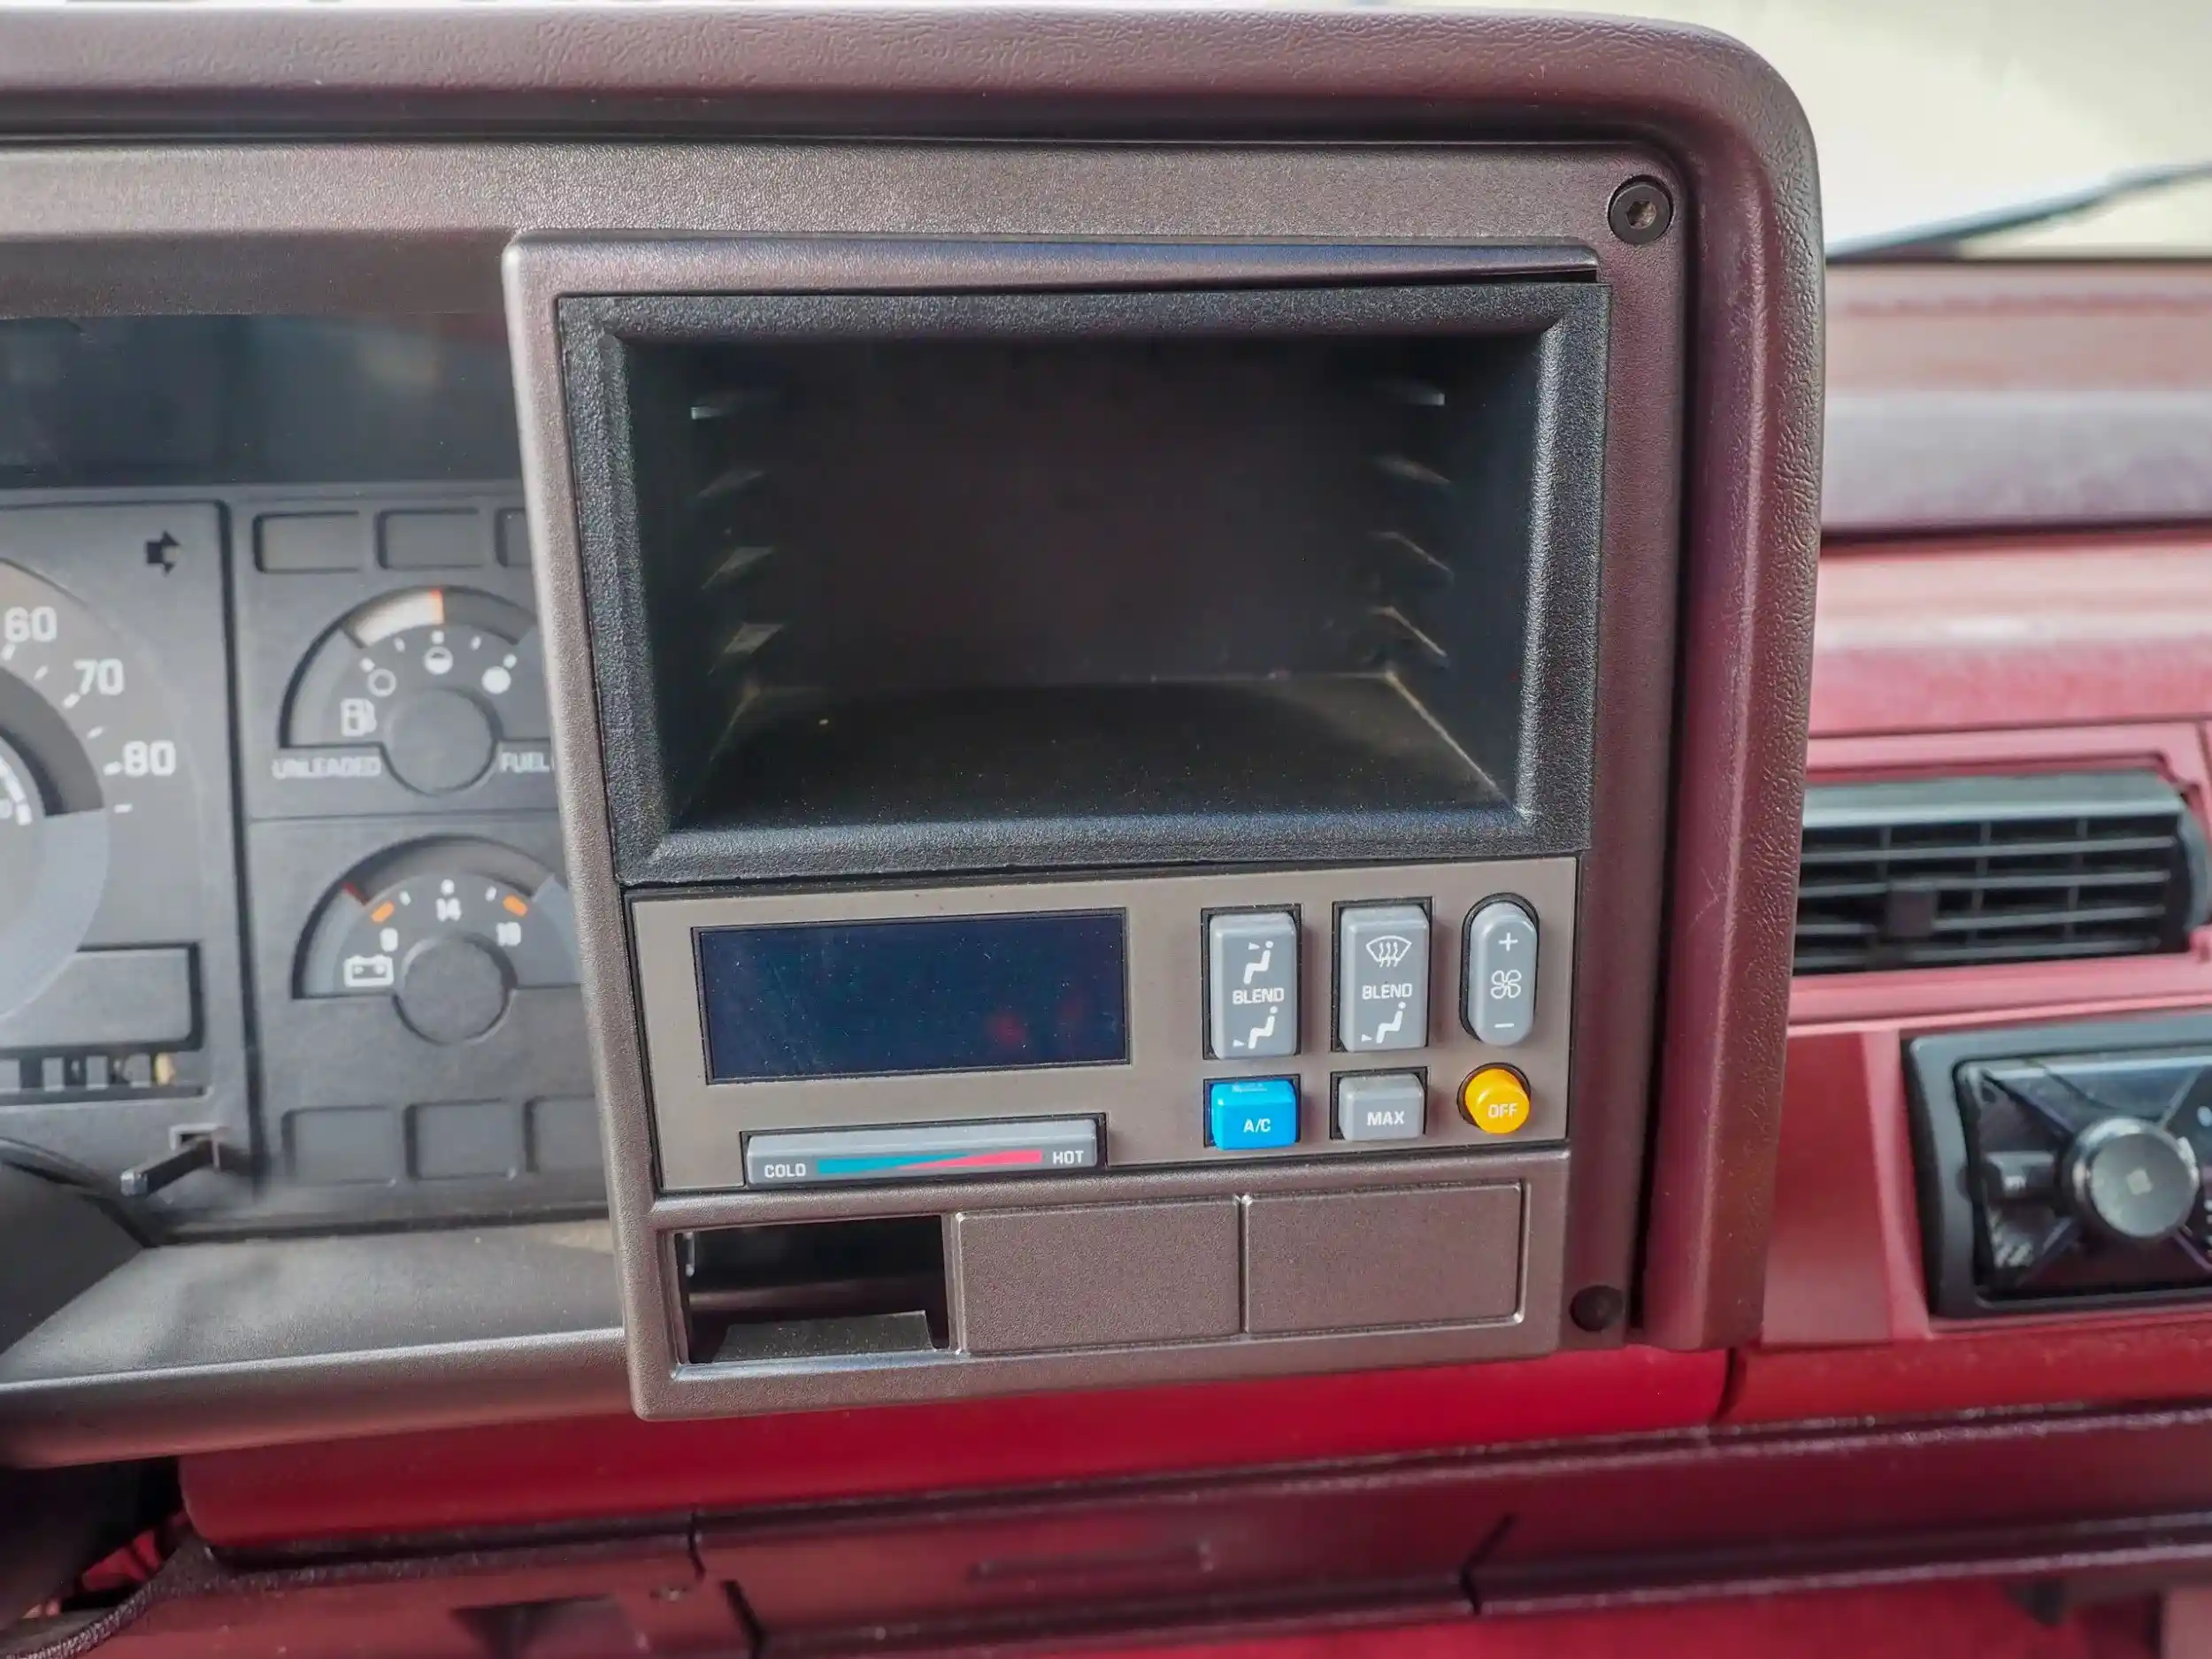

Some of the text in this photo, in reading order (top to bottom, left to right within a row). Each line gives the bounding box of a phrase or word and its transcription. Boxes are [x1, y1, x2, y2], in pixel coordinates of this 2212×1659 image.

[4, 606, 58, 642] 60
[73, 658, 124, 695] 70
[122, 740, 176, 777] 80
[272, 756, 382, 779] UNLEADED
[500, 752, 549, 773] FUEL
[1233, 987, 1284, 1005] BLEND
[1362, 983, 1412, 1000] BLEND
[1367, 1110, 1405, 1126] MAX
[1487, 1102, 1517, 1119] OFF
[1243, 1118, 1271, 1133] A/C
[764, 1150, 1085, 1179] COLD HOT
